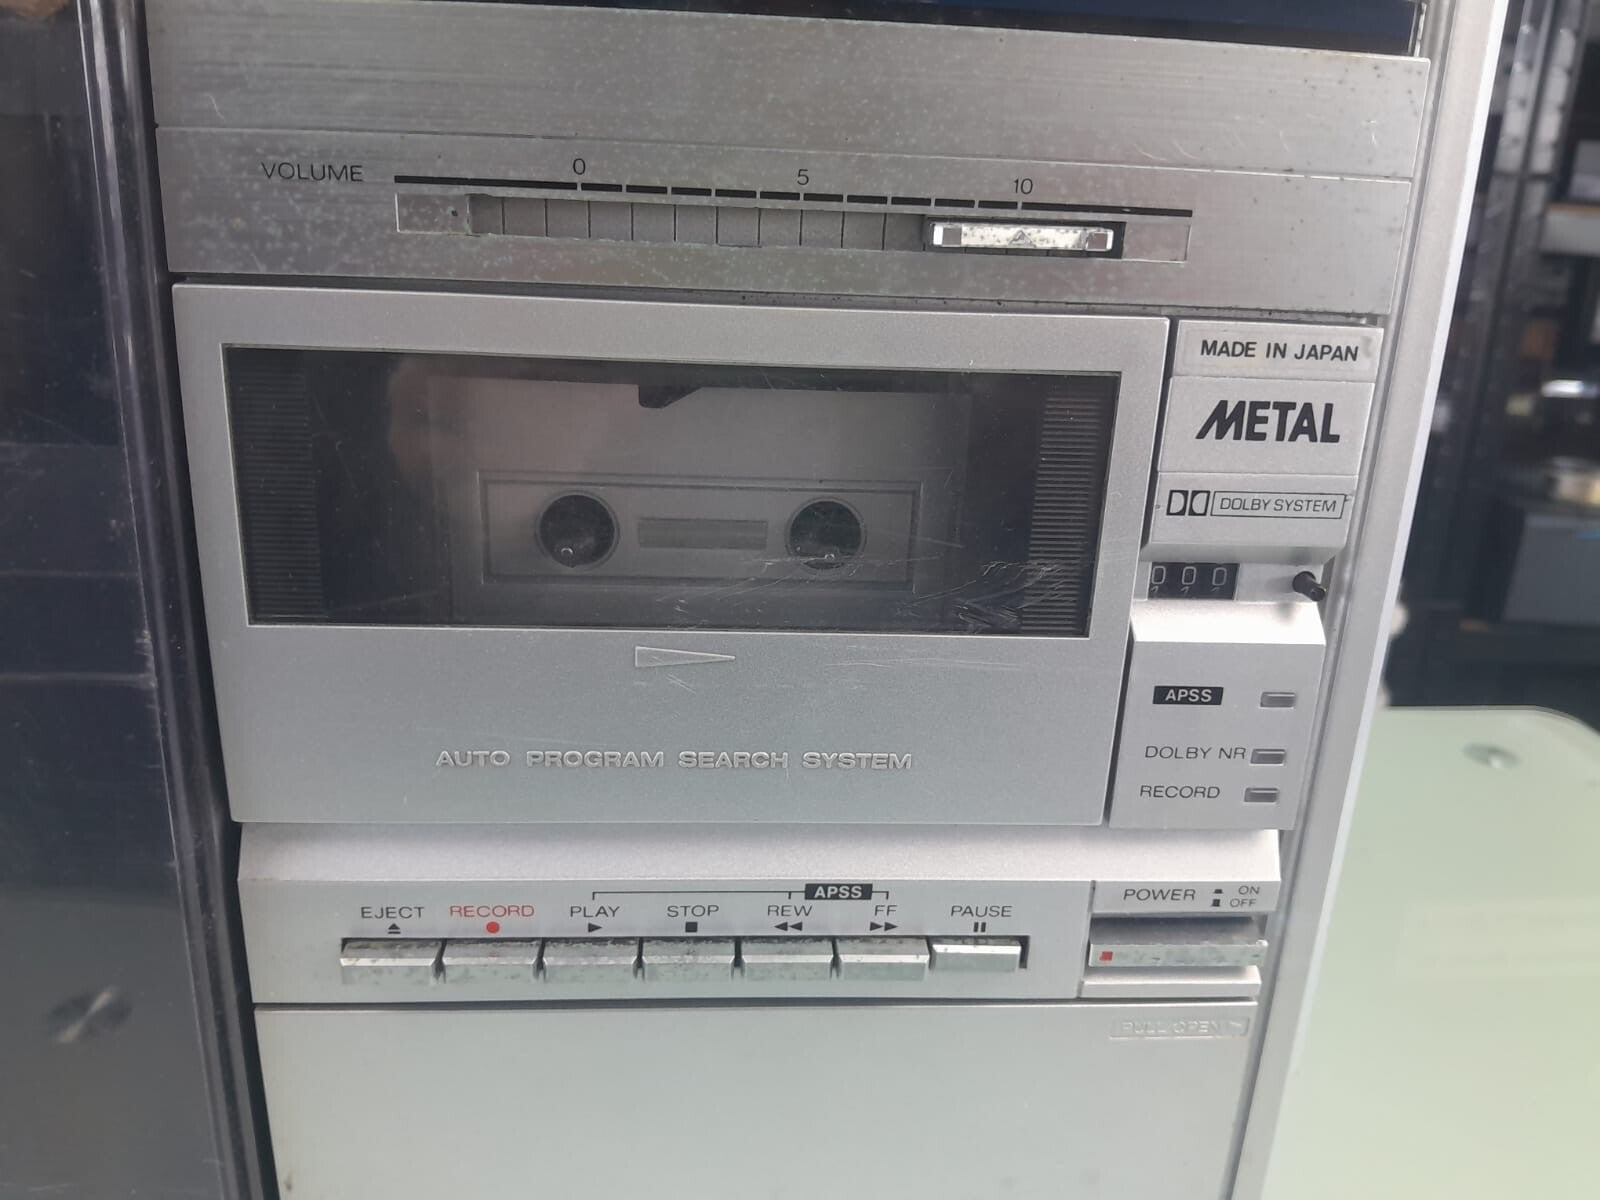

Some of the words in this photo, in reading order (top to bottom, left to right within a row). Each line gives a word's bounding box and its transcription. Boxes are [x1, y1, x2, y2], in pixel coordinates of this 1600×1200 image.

[261, 162, 364, 183] VOLUME
[572, 158, 587, 175] 0
[796, 168, 810, 186] 5
[1013, 178, 1034, 195] 10
[1200, 339, 1258, 358] MADE
[1265, 342, 1288, 359] IN
[1294, 343, 1359, 361] JAPAN
[1195, 400, 1341, 444] METAL
[1219, 497, 1270, 511] DOLBY
[1273, 498, 1337, 512] SYSTEM
[1164, 688, 1213, 703] APSS
[1144, 745, 1212, 760] DOLBY
[1218, 746, 1247, 760] NR
[434, 750, 511, 768] AUTO
[526, 750, 664, 769] PROGRAM
[678, 750, 789, 769] SEARCH
[802, 751, 912, 770] SYSTEM
[1139, 785, 1221, 799] RECORD
[813, 885, 863, 899] APSS
[1123, 887, 1196, 901] POWER
[1238, 885, 1260, 895] ON
[1229, 898, 1257, 908] OFF
[360, 905, 425, 919] EJECT
[449, 904, 536, 918] RECORD
[569, 905, 621, 918] PLAY
[666, 904, 720, 918] STOP
[767, 904, 813, 917] REW
[874, 904, 898, 917] FF
[951, 905, 1013, 918] PAUSE
